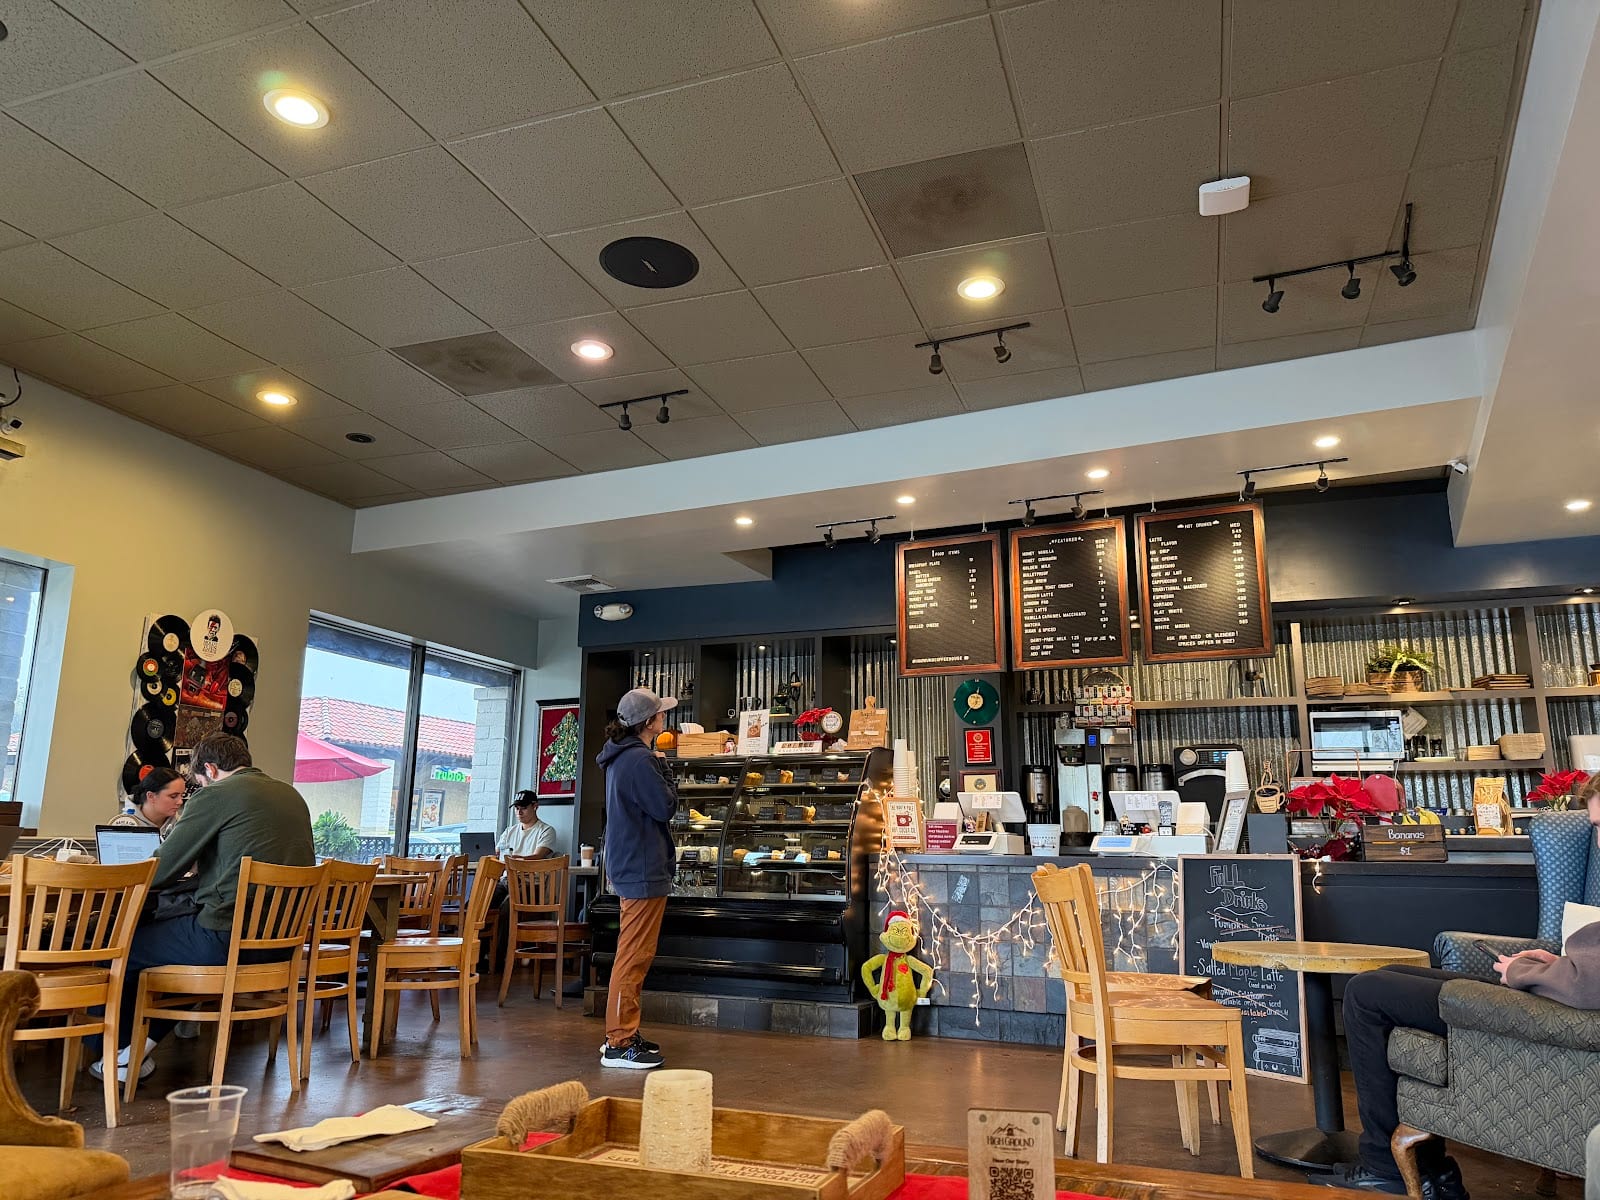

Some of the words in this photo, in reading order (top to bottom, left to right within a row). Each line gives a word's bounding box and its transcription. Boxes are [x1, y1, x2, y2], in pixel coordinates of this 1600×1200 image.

[1220, 888, 1268, 912] Drinks
[1261, 967, 1285, 982] Latte
[740, 1166, 784, 1176] COCOA
